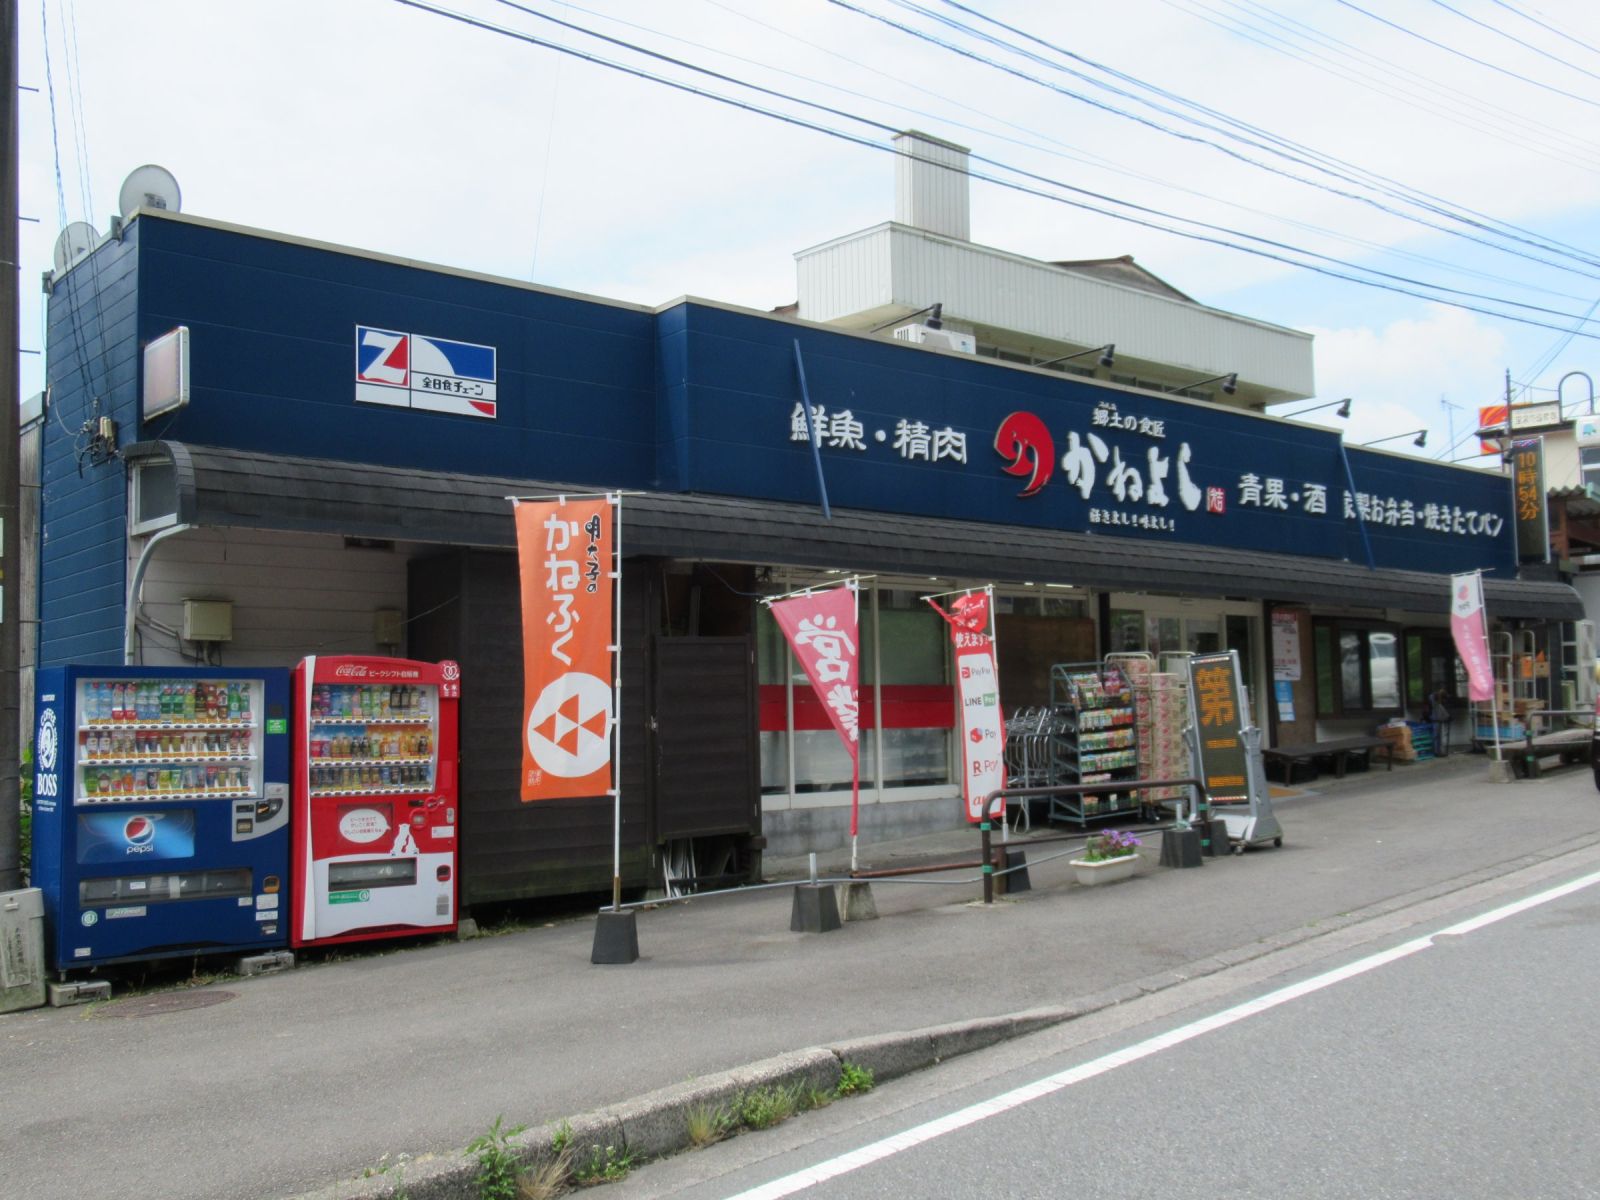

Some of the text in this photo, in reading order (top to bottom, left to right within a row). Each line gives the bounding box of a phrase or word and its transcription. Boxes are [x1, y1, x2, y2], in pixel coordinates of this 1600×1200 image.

[421, 376, 484, 397] 全日食チェーン
[790, 402, 968, 465] 鮮魚・精肉
[1061, 431, 1202, 512] かねよし
[1238, 473, 1328, 514] 青果・酒
[543, 513, 580, 666] かねふく
[965, 697, 982, 706] LINE
[37, 773, 57, 797] BOSS
[126, 845, 154, 855] pepsi
